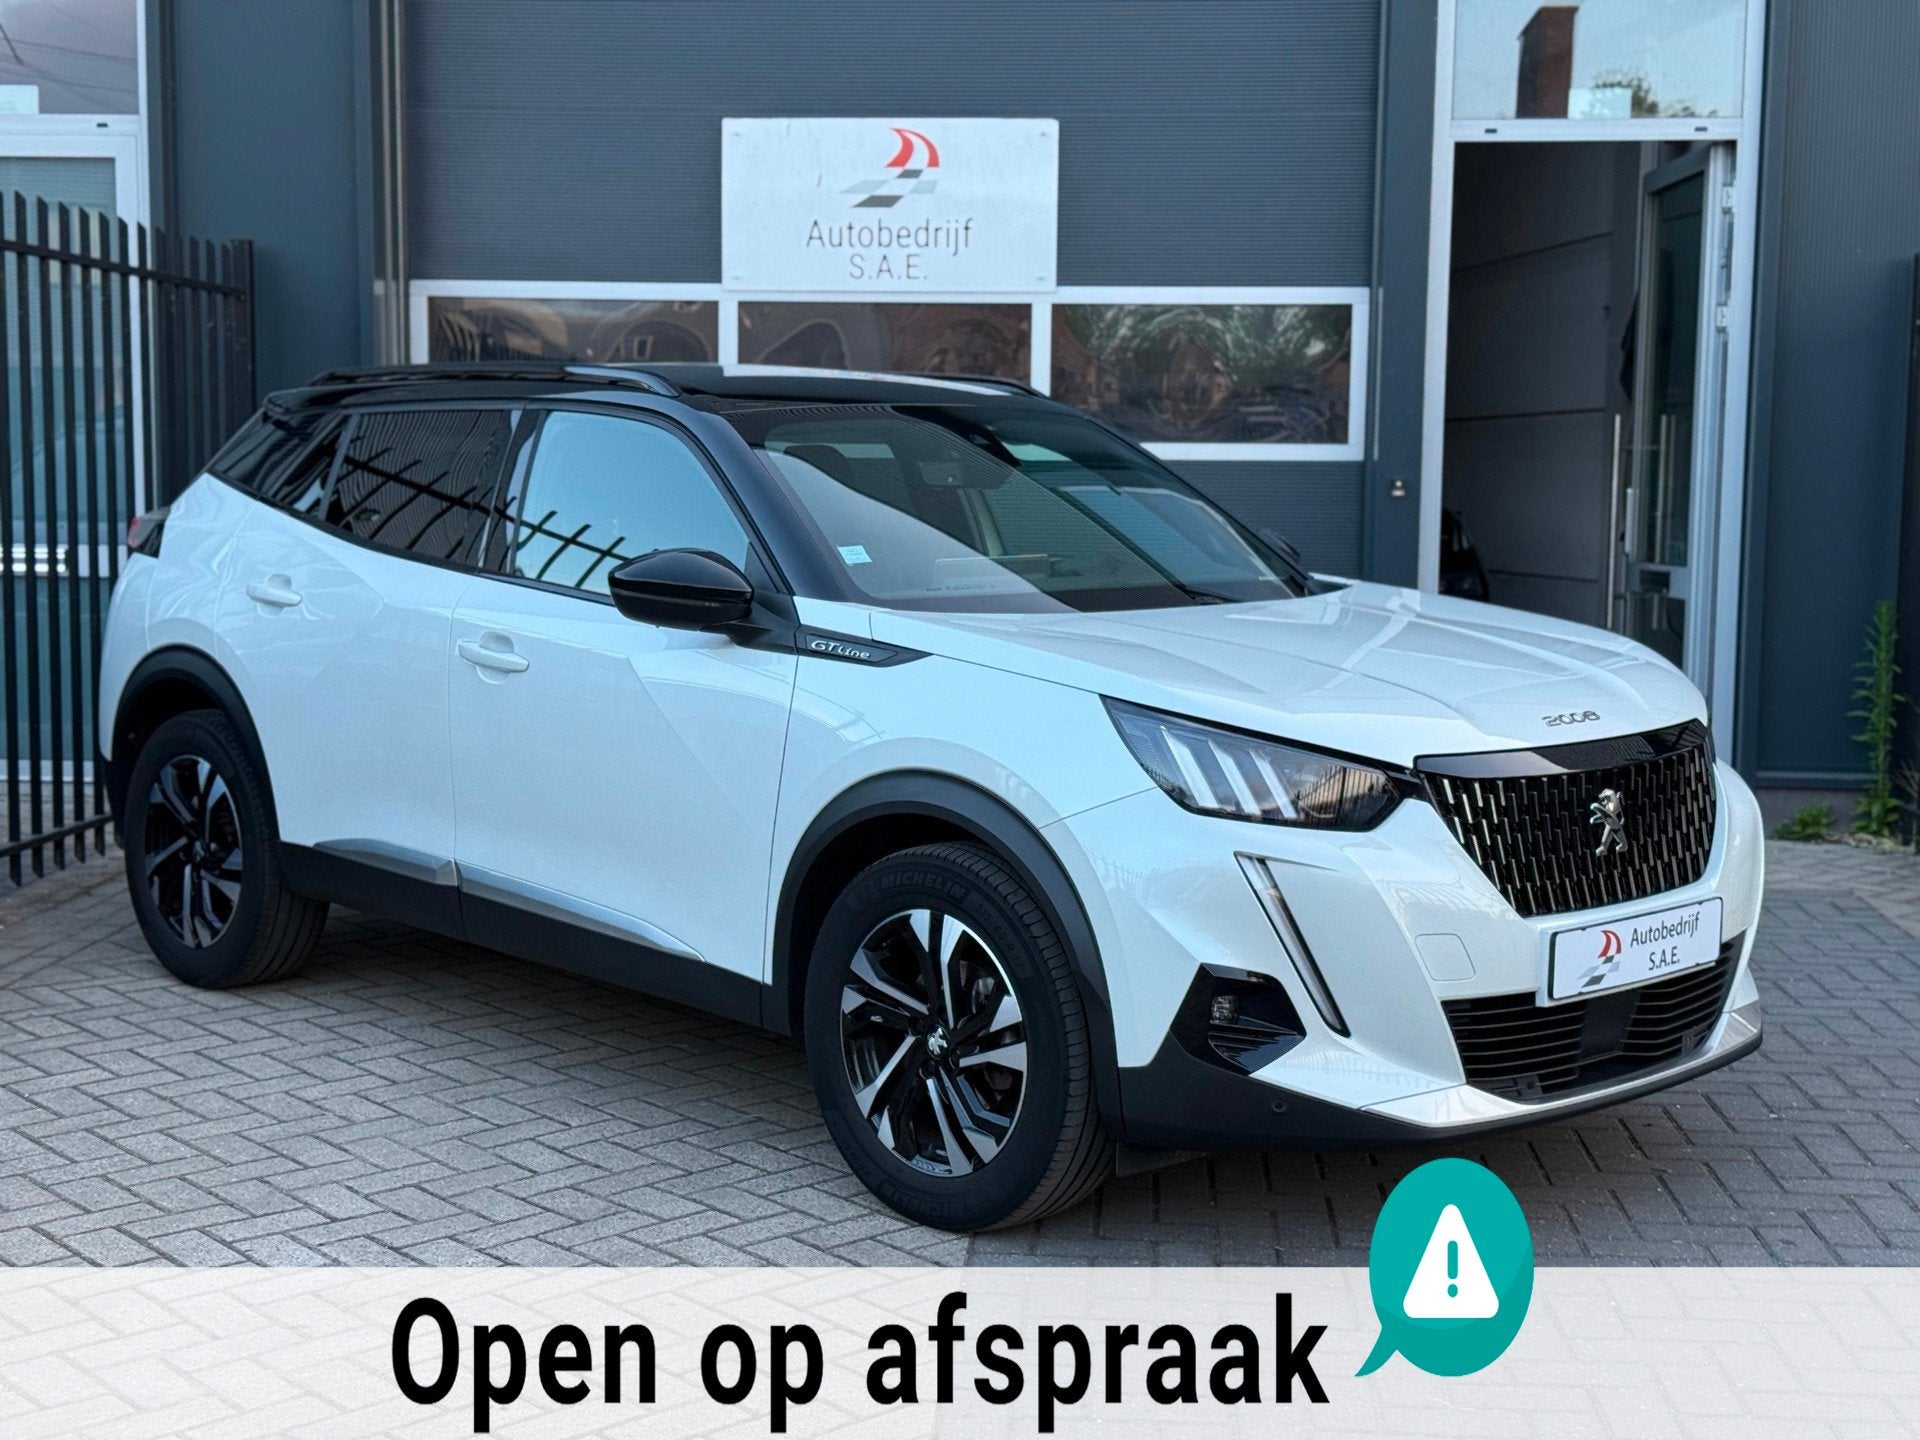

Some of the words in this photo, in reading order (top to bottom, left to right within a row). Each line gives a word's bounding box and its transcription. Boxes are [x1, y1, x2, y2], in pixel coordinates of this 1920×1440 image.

[806, 218, 973, 256] Autobedrijf
[849, 254, 928, 280] S.A.E.
[1541, 710, 1601, 728] 2008
[881, 871, 967, 900] MICHELIN
[1630, 911, 1700, 947] Autobedrijf
[1648, 946, 1681, 971] S.A.E.
